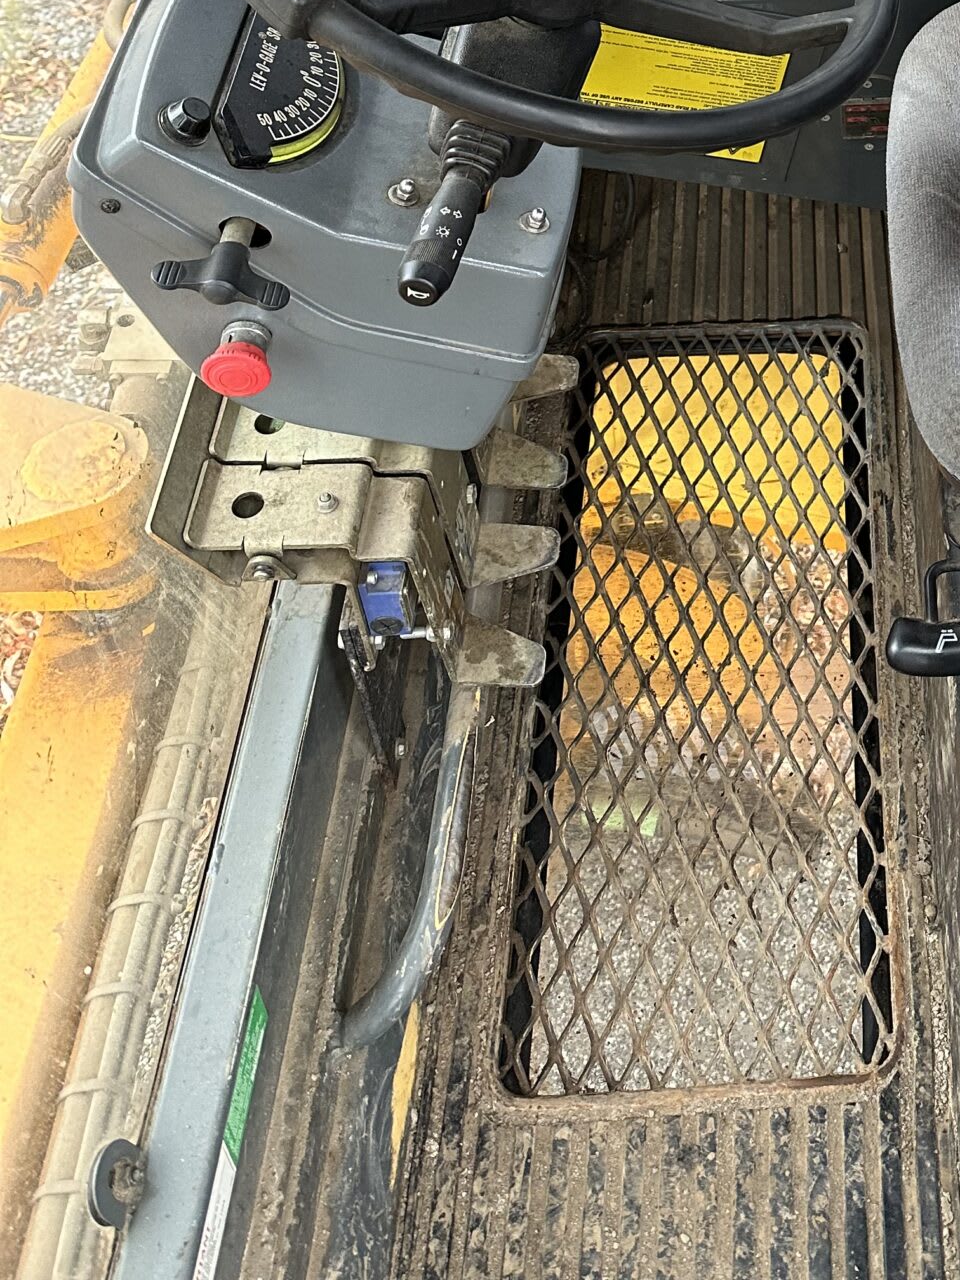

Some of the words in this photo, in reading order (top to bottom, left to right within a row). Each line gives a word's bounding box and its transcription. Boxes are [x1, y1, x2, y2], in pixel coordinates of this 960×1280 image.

[309, 51, 323, 64] 20
[310, 65, 324, 77] 10
[303, 88, 317, 101] 10
[295, 96, 310, 111] 20
[273, 110, 287, 123] 40
[284, 104, 300, 118] 30
[256, 113, 272, 126] 50
